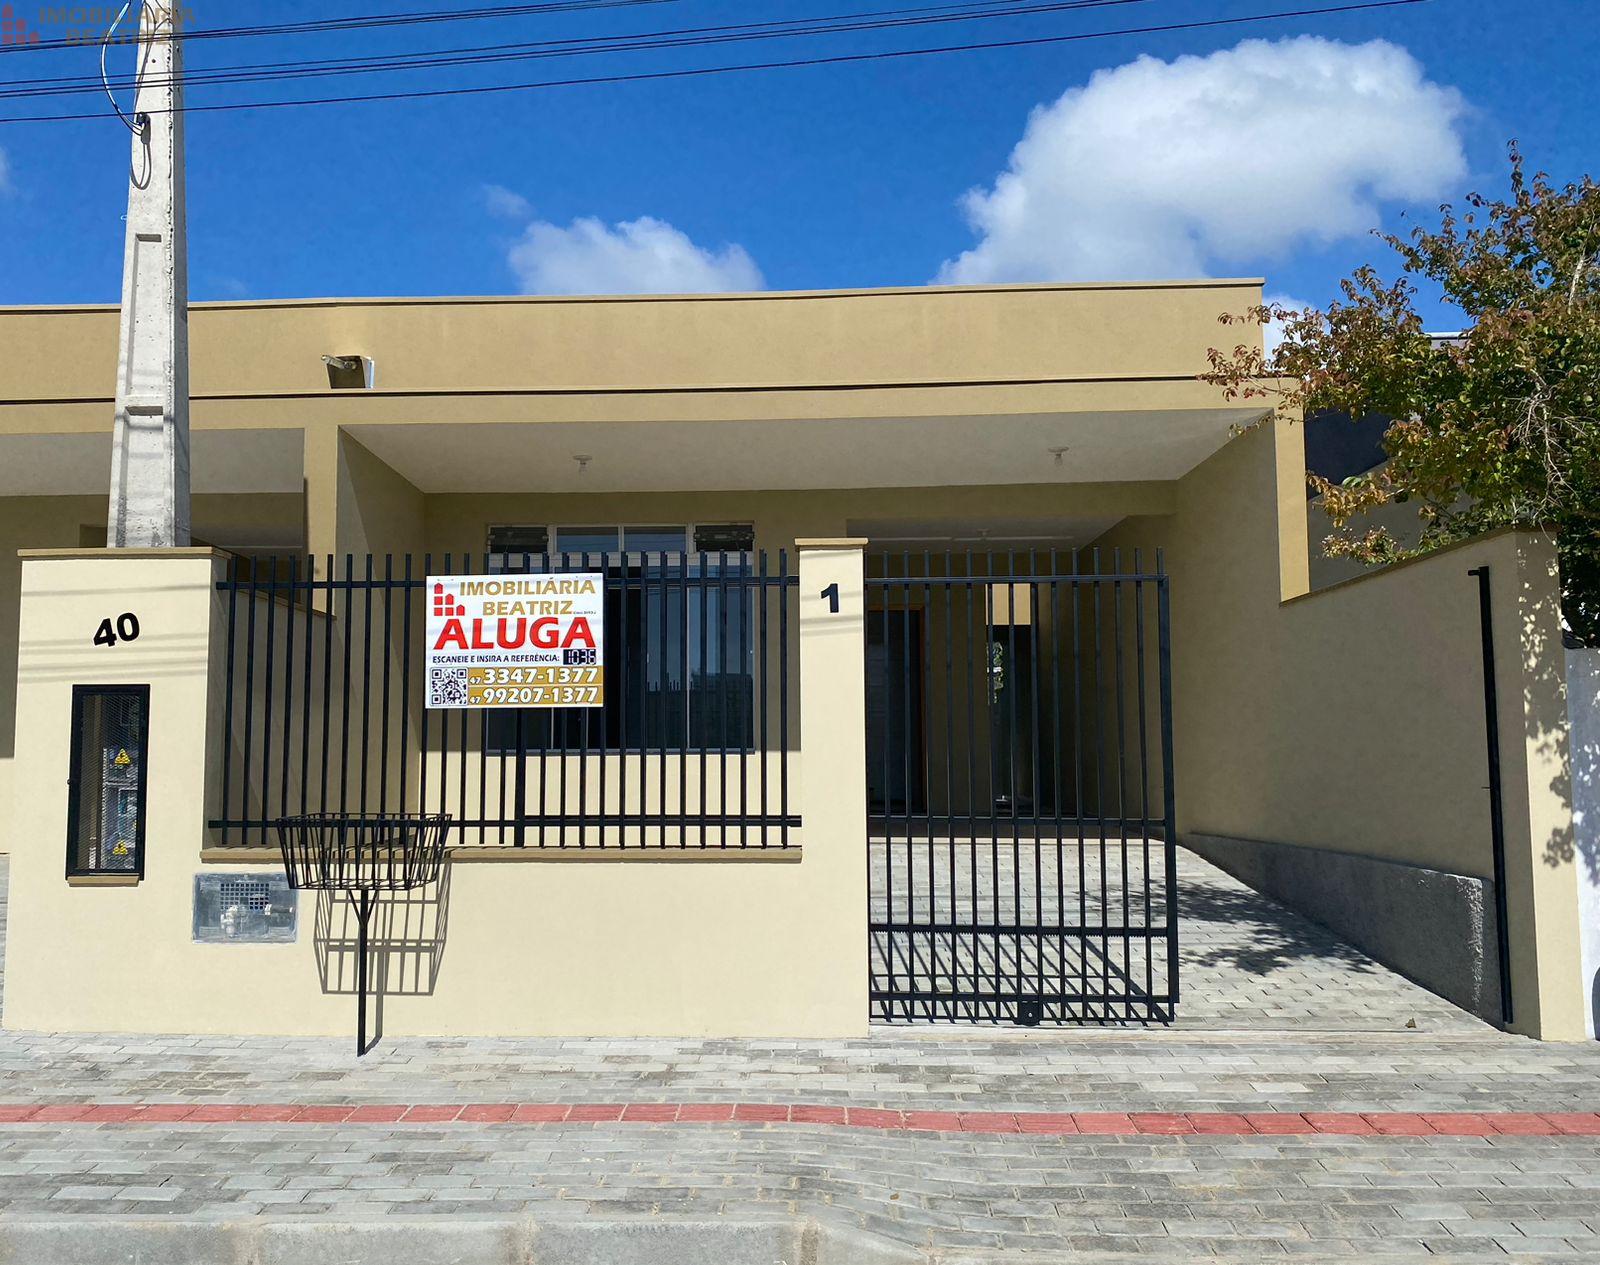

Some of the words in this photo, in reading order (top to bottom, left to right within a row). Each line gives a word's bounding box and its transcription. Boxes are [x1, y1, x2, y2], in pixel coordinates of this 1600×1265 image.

[460, 577, 596, 596] IMOBILIÁRIA
[820, 583, 839, 613] 1
[482, 600, 573, 616] BEATRIZ
[93, 612, 140, 647] 40
[433, 616, 597, 650] ALUGA
[432, 655, 469, 664] ESCANEIE
[470, 655, 476, 663] E
[476, 654, 501, 663] INSIRA
[503, 654, 510, 662] A
[510, 652, 560, 663] REFERÊNCIA:
[469, 676, 482, 684] 47
[483, 668, 598, 685] 3347-1377
[469, 695, 482, 704] 47
[482, 687, 598, 704] 99207-1377
